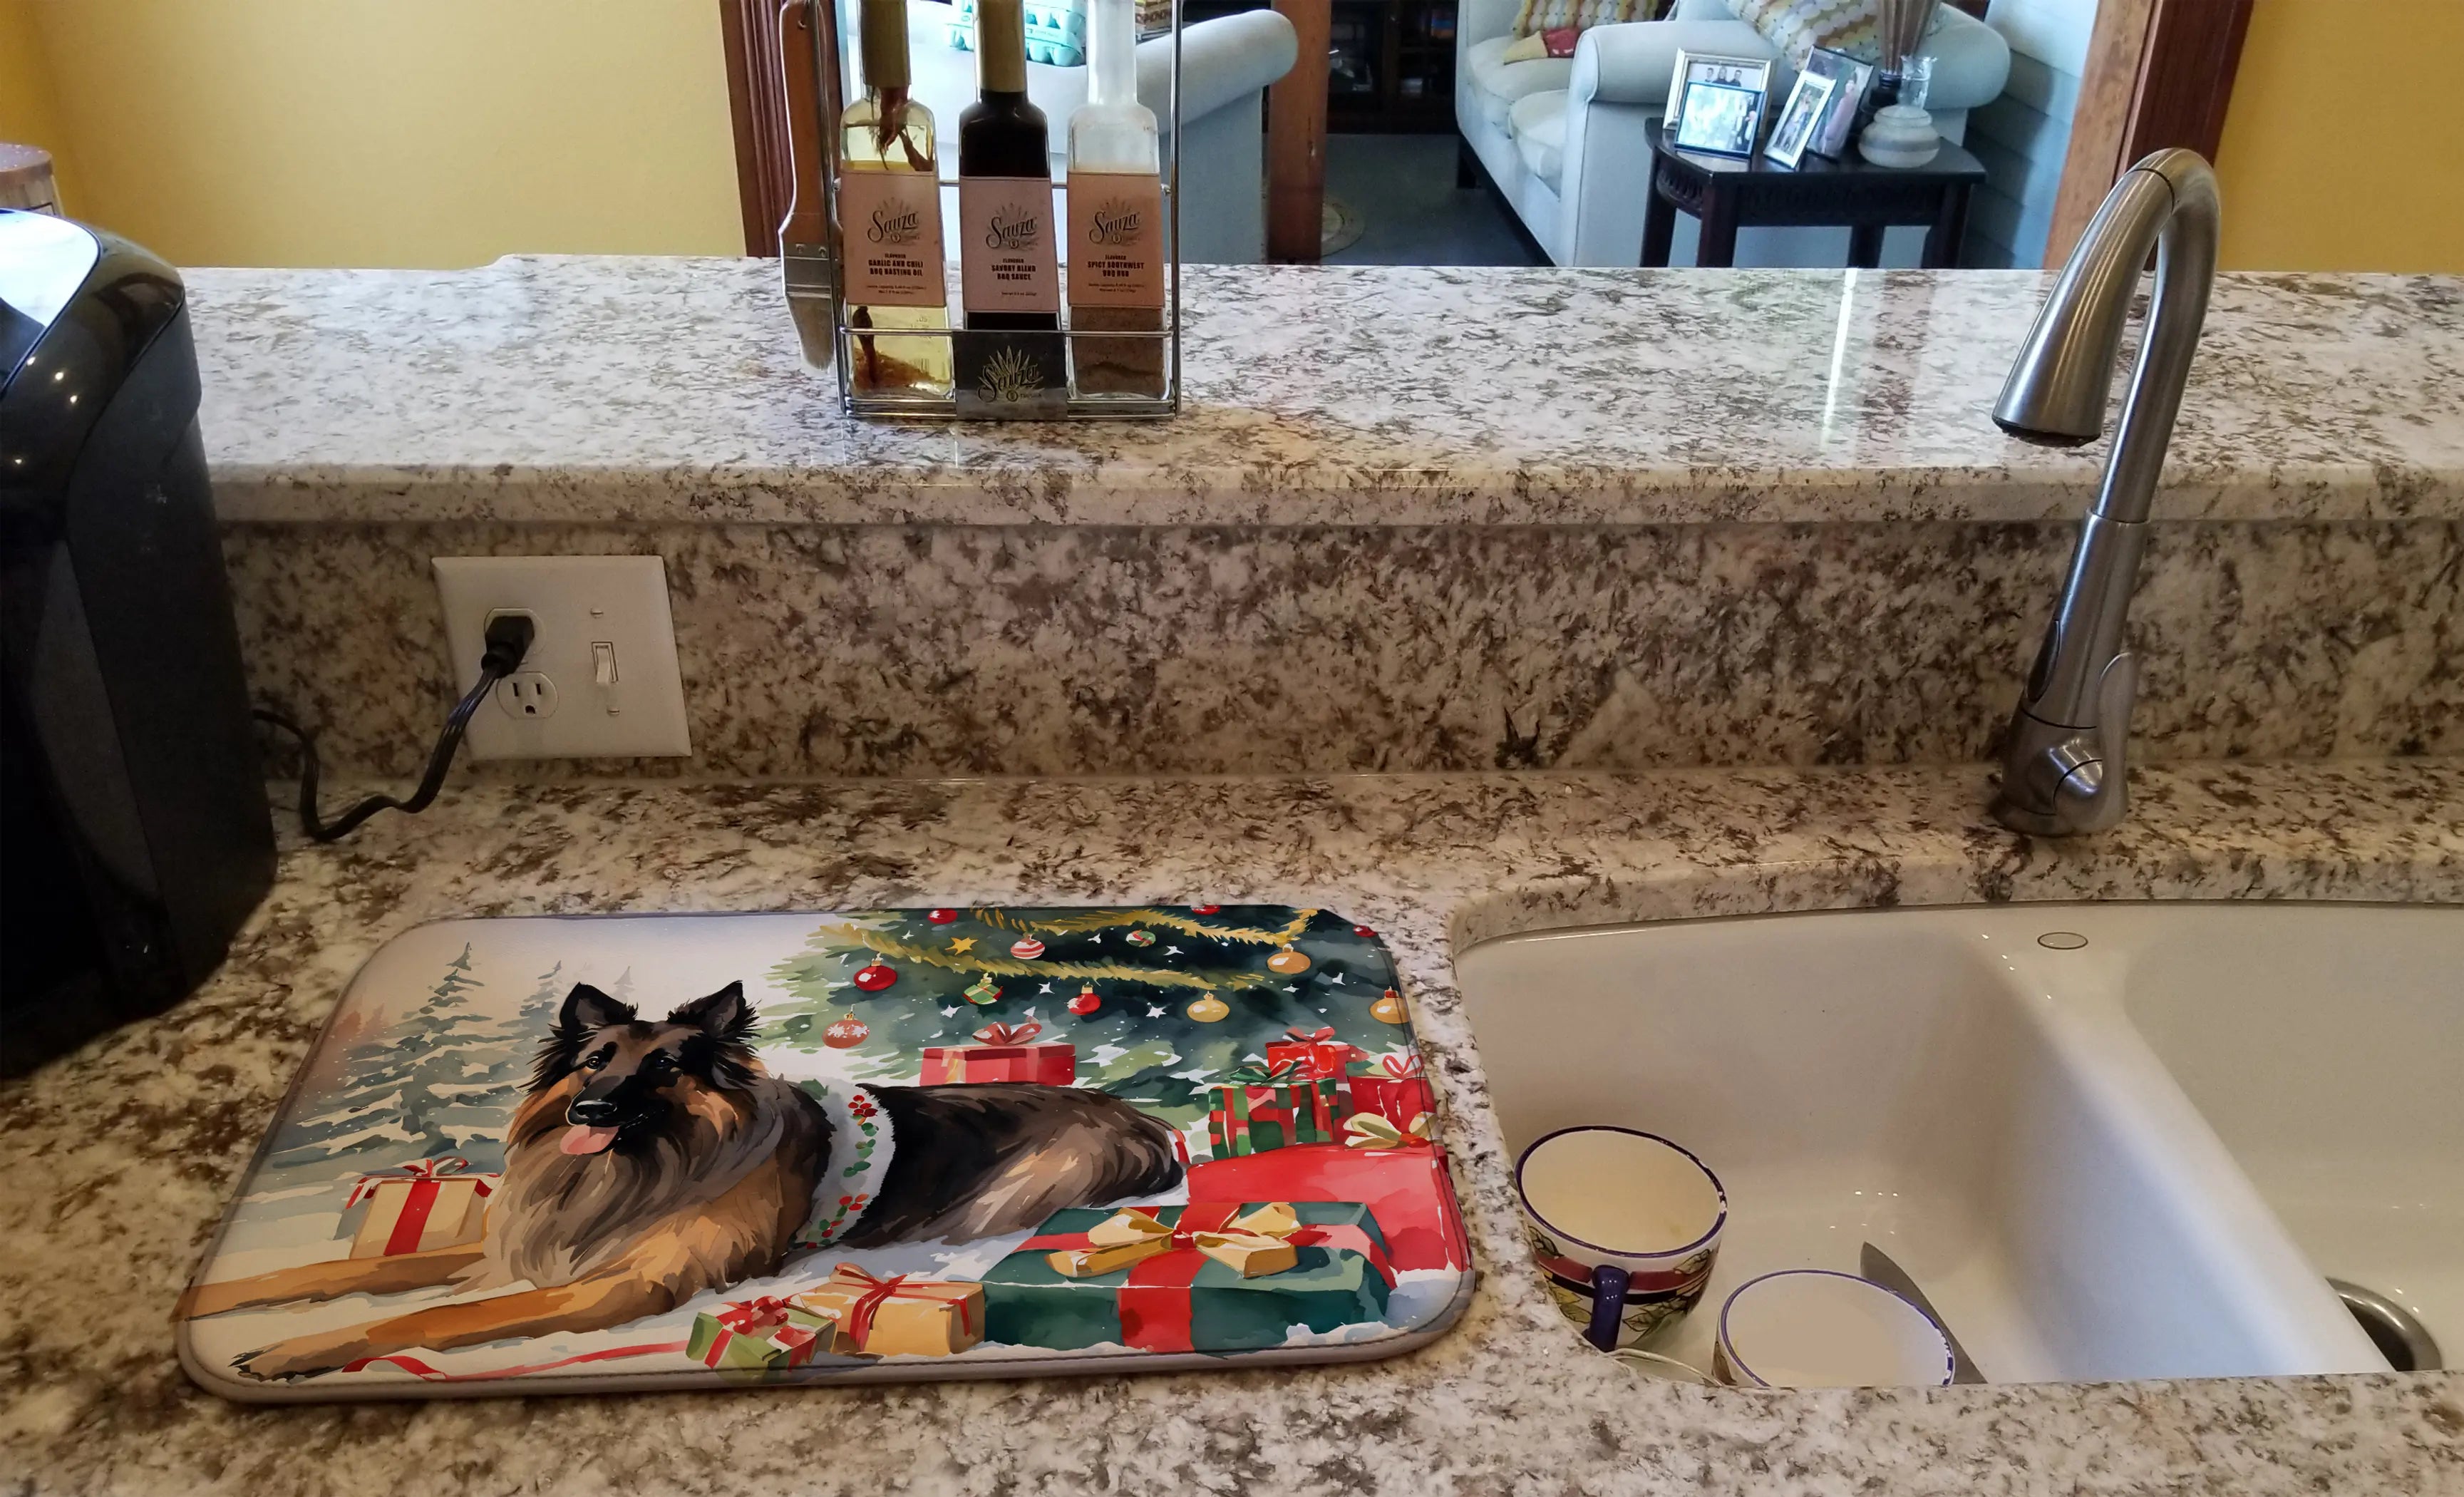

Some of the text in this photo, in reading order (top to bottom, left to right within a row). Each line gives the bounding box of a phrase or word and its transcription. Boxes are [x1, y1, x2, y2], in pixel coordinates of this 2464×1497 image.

[867, 210, 919, 242] Sauza
[986, 216, 1038, 249] Sauza
[1089, 211, 1140, 243] Sauza
[977, 364, 1040, 402] Sauza
